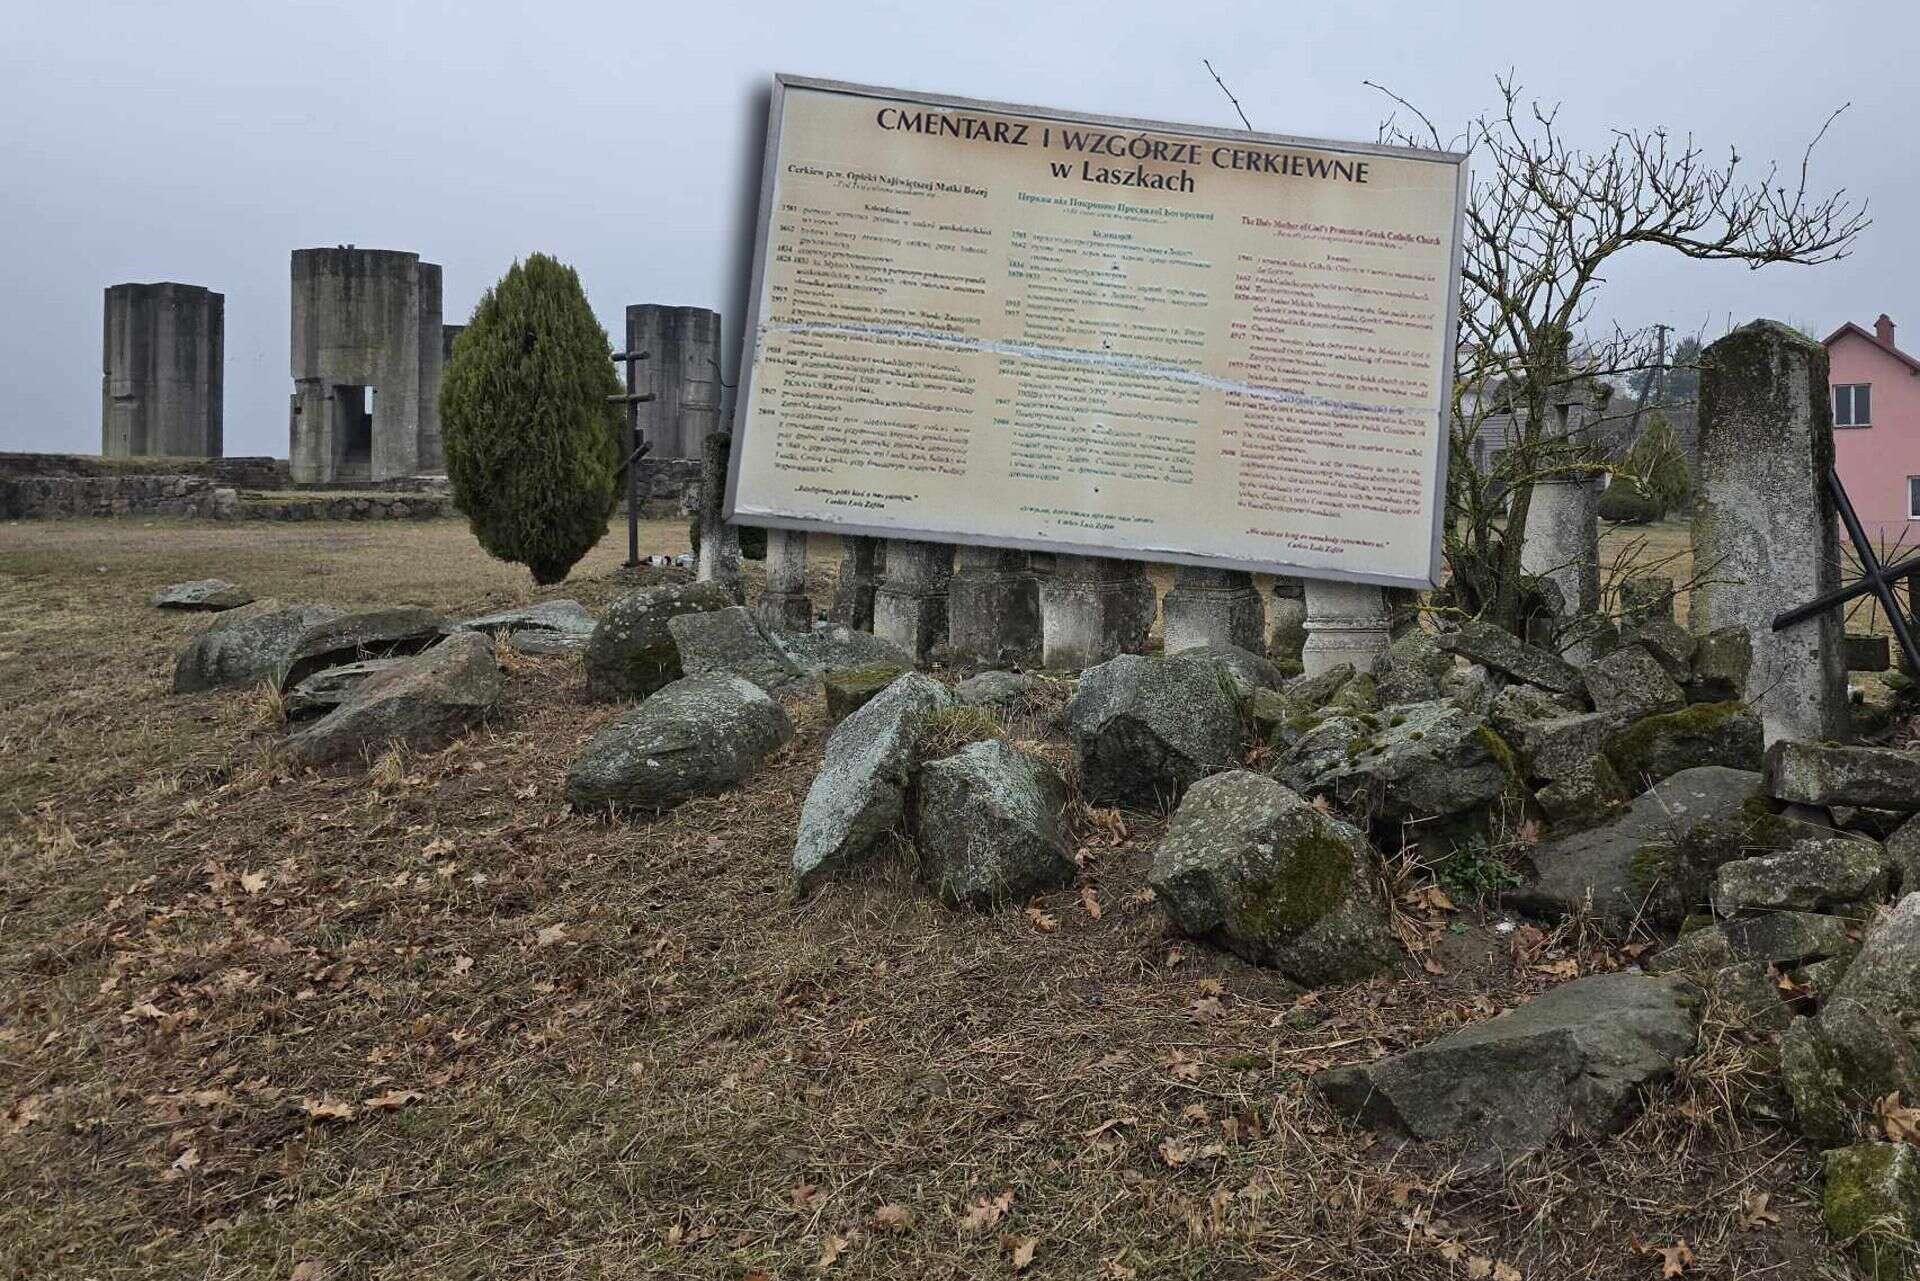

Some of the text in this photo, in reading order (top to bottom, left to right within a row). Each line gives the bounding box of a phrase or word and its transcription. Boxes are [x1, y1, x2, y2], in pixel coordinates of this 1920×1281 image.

[877, 108, 1369, 183] CMENTARZ I WZGÓRZE CERKIEWNE
[935, 182, 963, 193] Matki
[1050, 160, 1195, 193] w Laszkach
